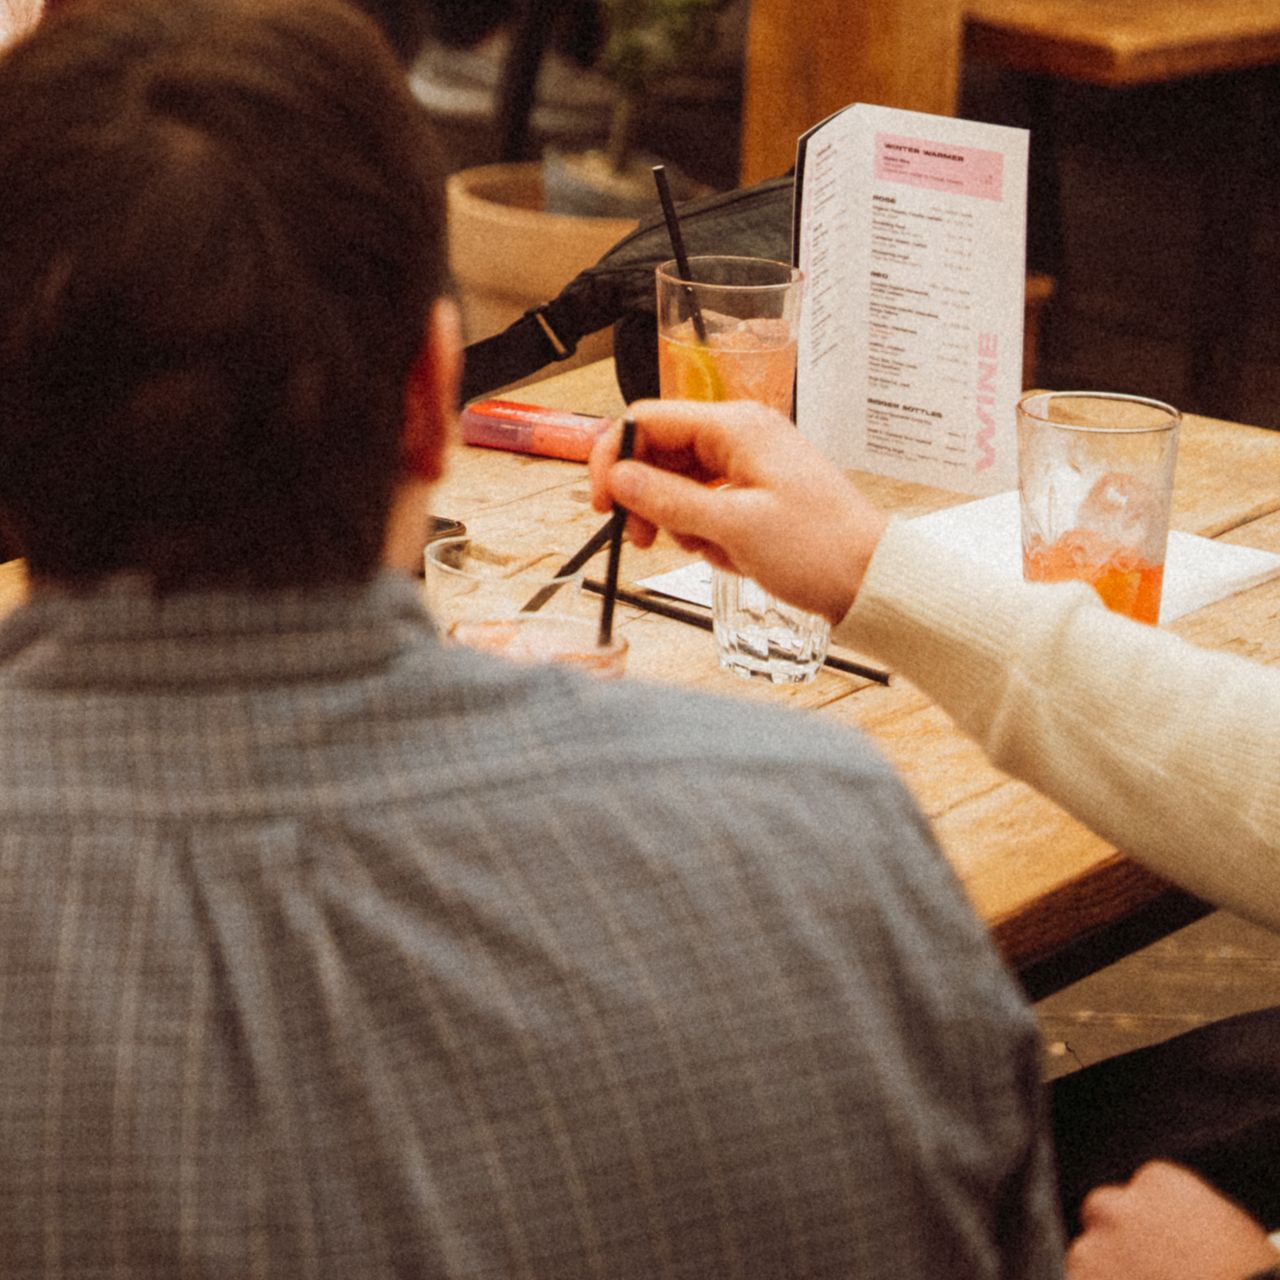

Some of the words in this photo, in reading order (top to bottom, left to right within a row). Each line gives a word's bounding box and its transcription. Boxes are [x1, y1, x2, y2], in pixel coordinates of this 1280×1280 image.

[884, 142, 920, 155] WINTER
[923, 150, 965, 163] WARMER
[901, 403, 944, 419] BOTTLES
[975, 332, 999, 474] WINE
